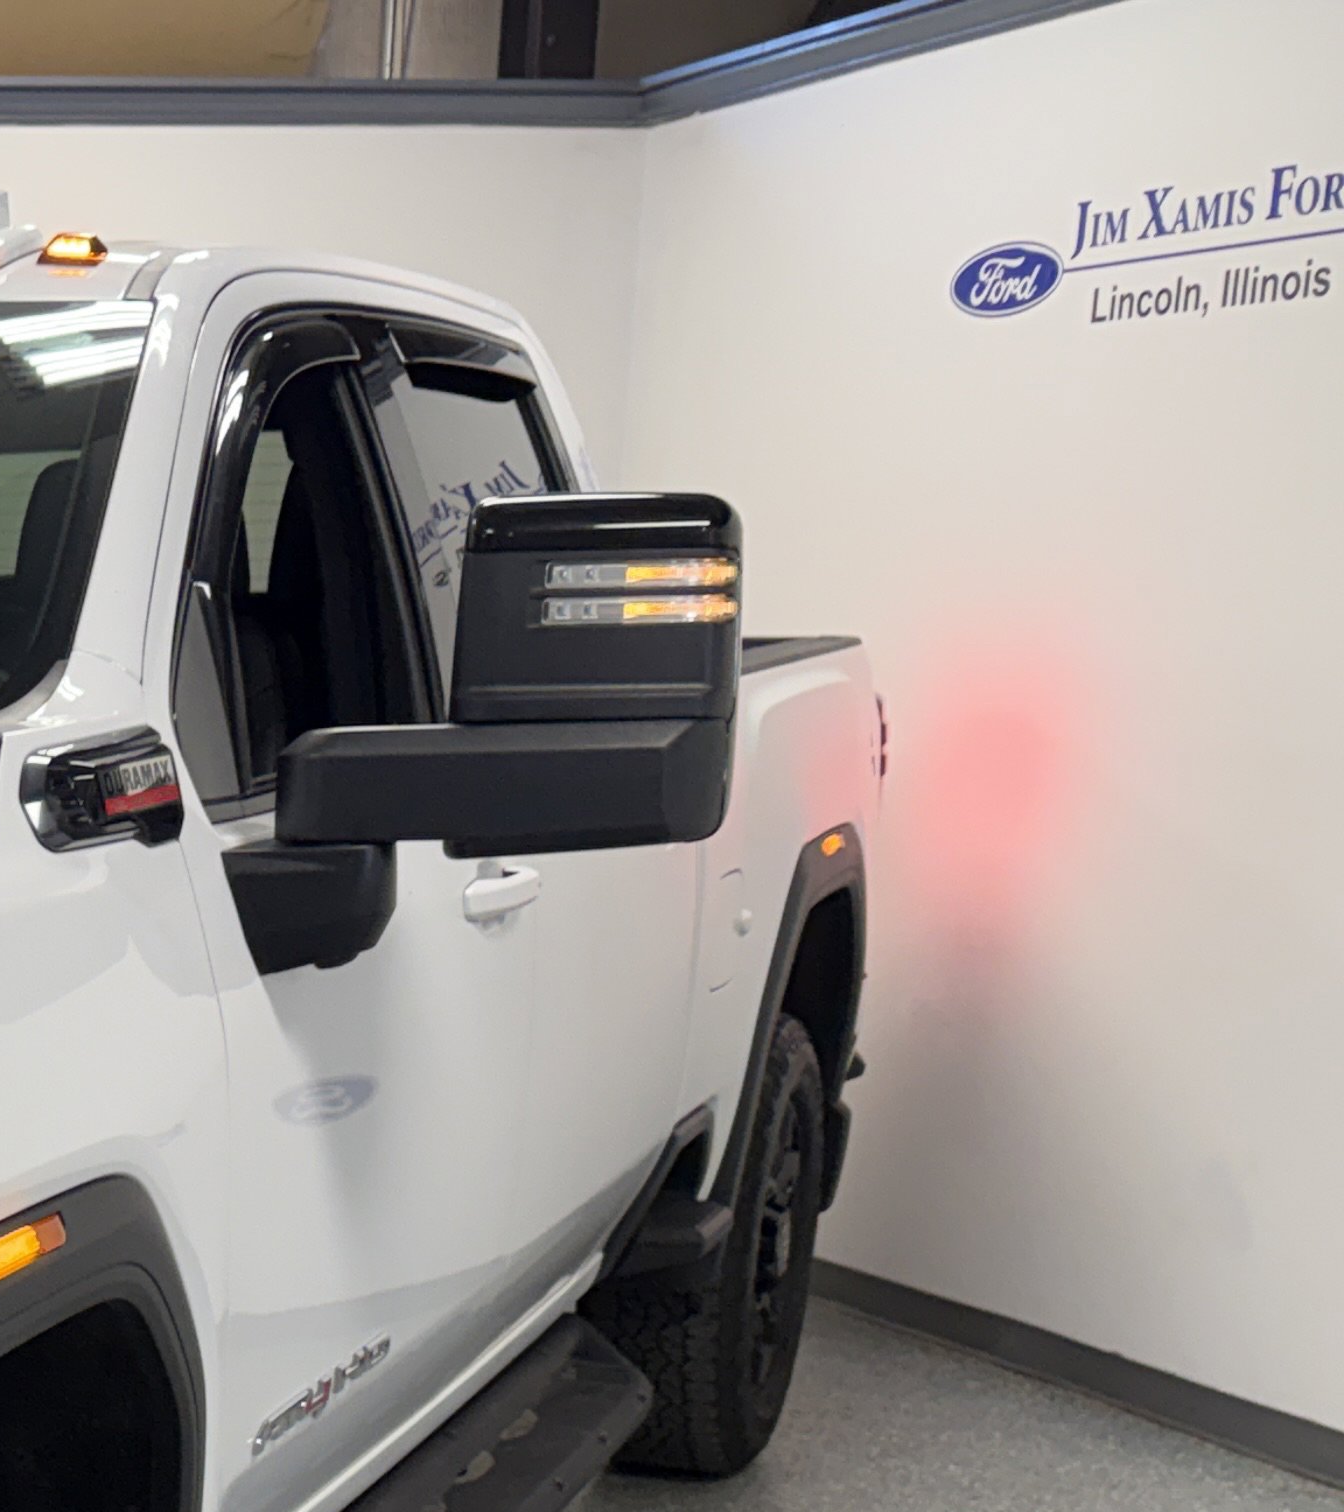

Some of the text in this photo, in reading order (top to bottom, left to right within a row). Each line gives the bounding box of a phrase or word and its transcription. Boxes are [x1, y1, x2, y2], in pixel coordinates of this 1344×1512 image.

[1071, 201, 1129, 260] JIM
[1137, 186, 1256, 240] XAMIS
[970, 256, 1043, 307] Ford
[1090, 259, 1332, 323] Lincoln, Illinois
[104, 758, 173, 795] DURAMAX
